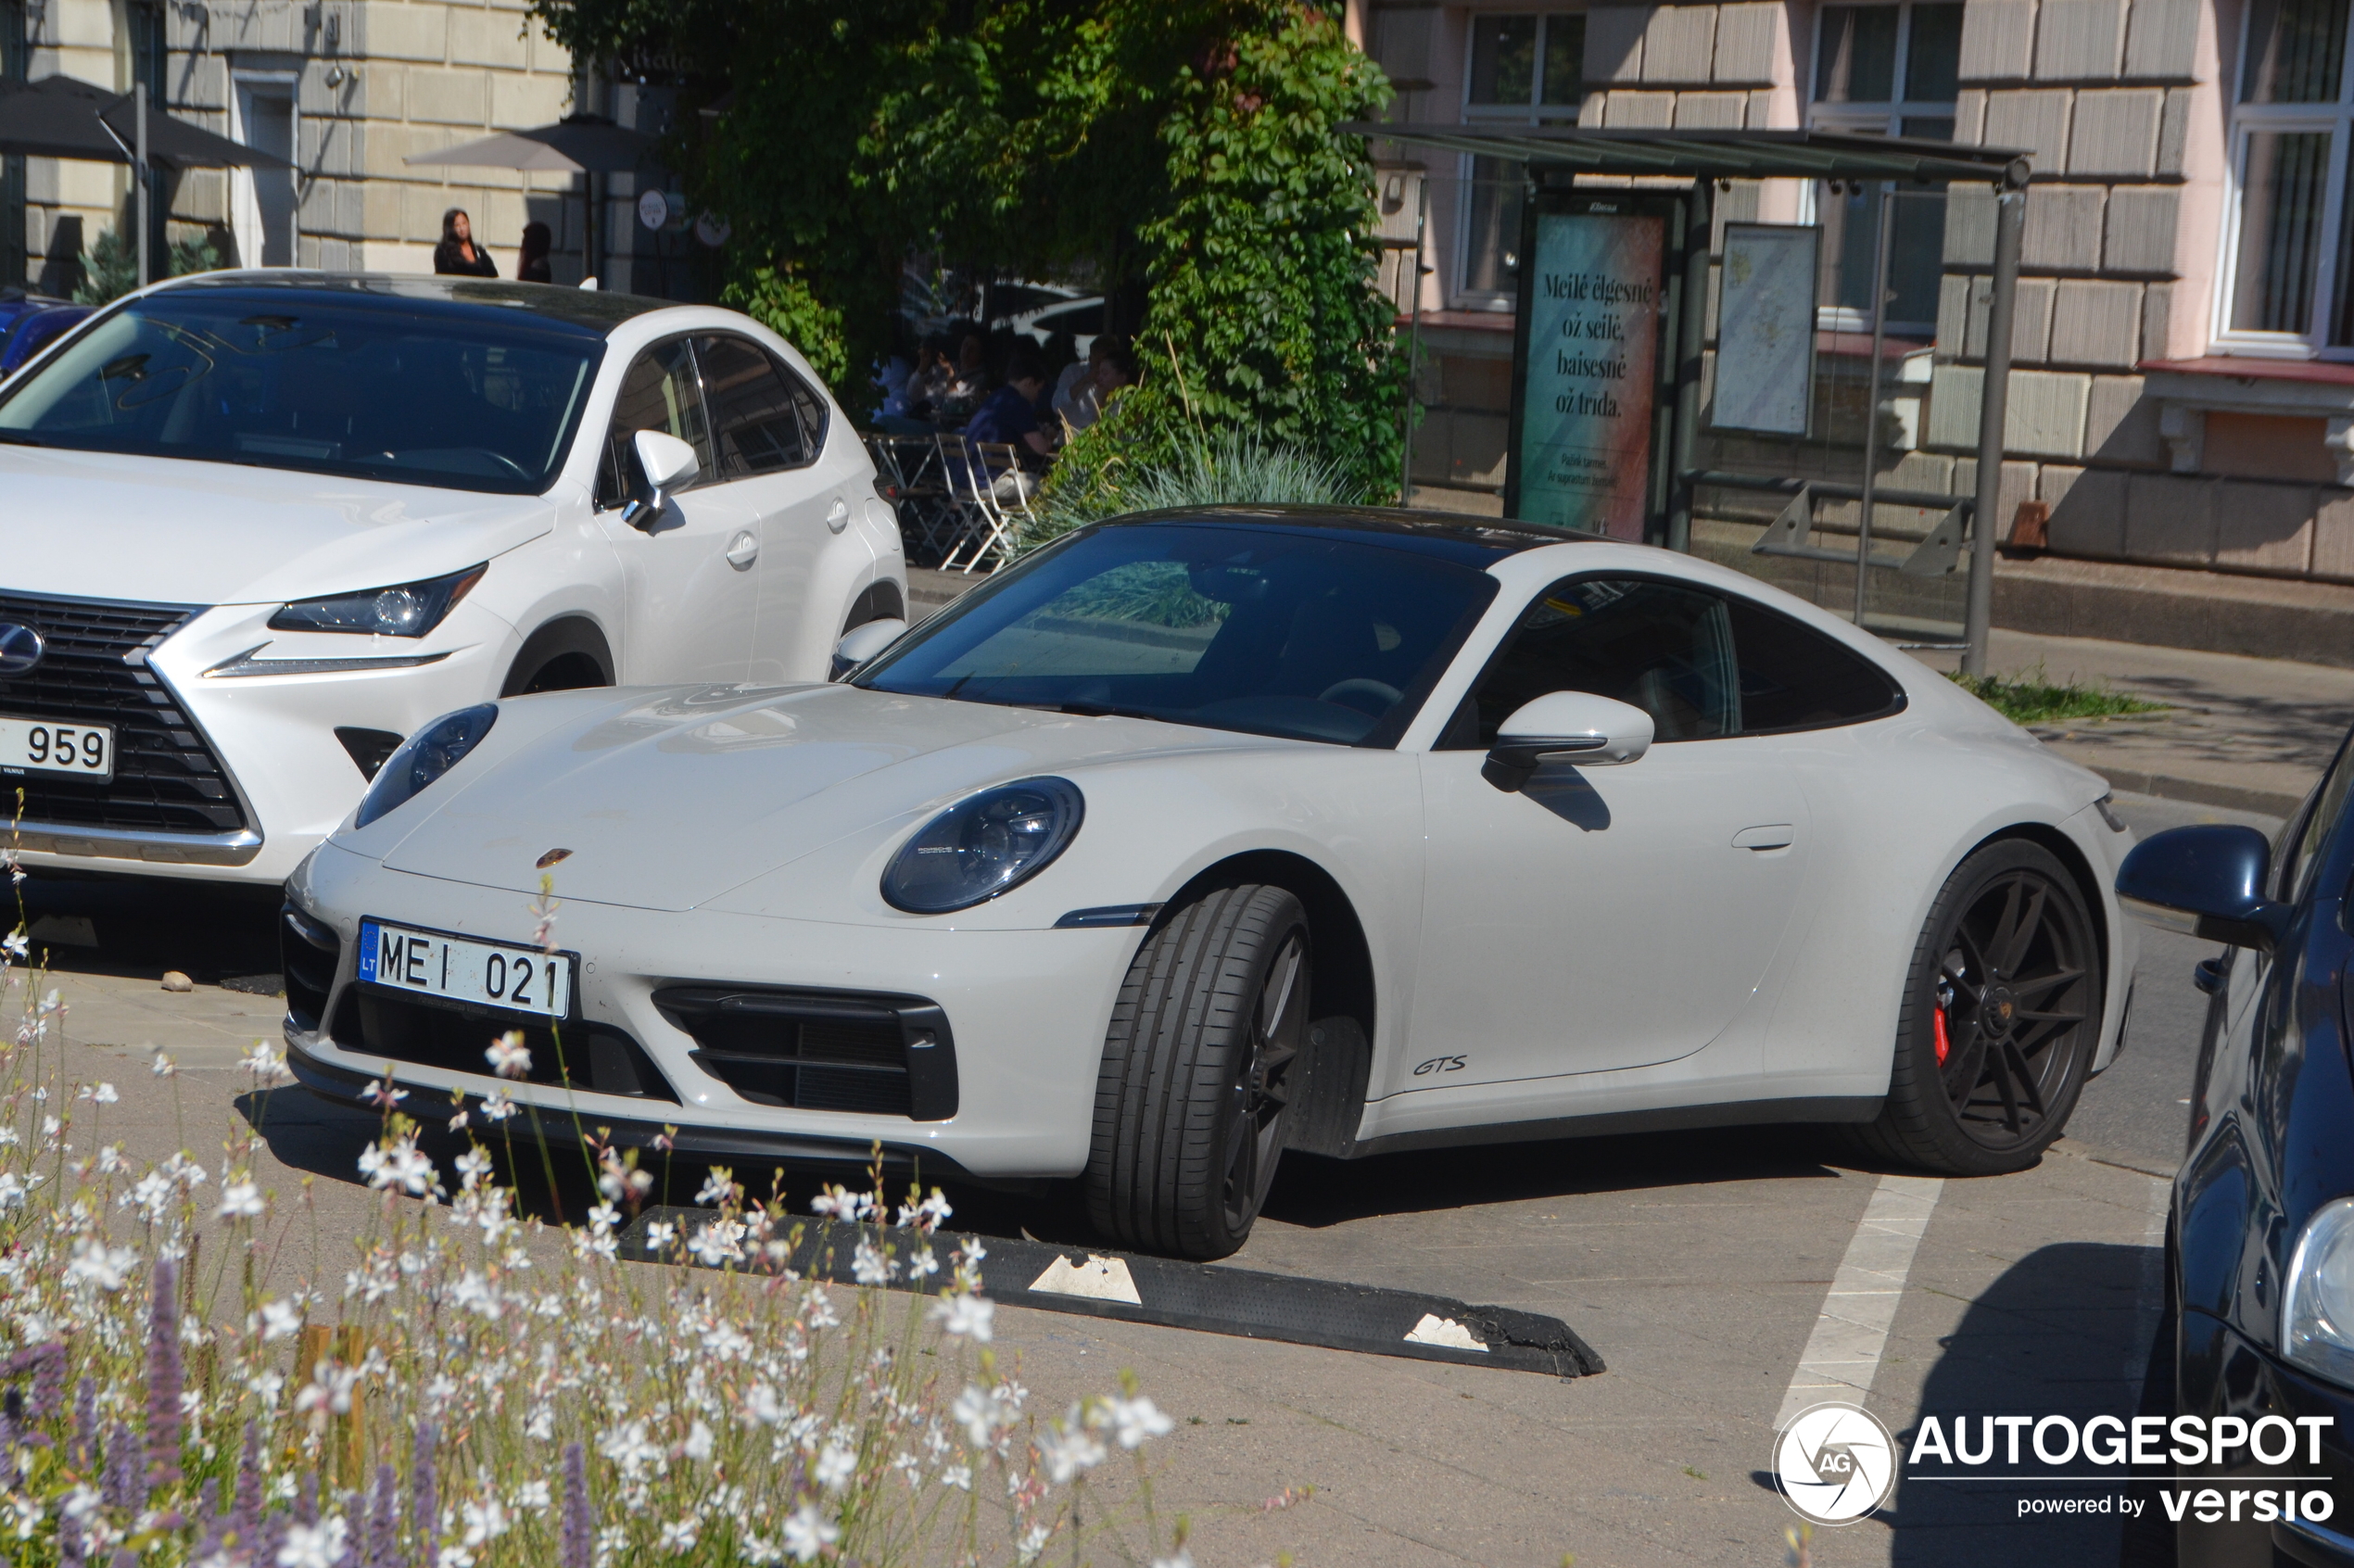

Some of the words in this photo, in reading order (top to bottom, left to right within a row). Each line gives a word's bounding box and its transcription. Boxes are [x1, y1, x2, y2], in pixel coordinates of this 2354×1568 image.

[1543, 272, 1588, 300] Meilė
[1563, 310, 1582, 338] ož
[1557, 348, 1627, 379] baisesnė
[1555, 386, 1576, 413] ož
[28, 726, 104, 769] 959
[361, 956, 375, 973] LT
[380, 930, 449, 990] MEI
[485, 952, 557, 1008] 021
[1413, 1055, 1468, 1076] GTS
